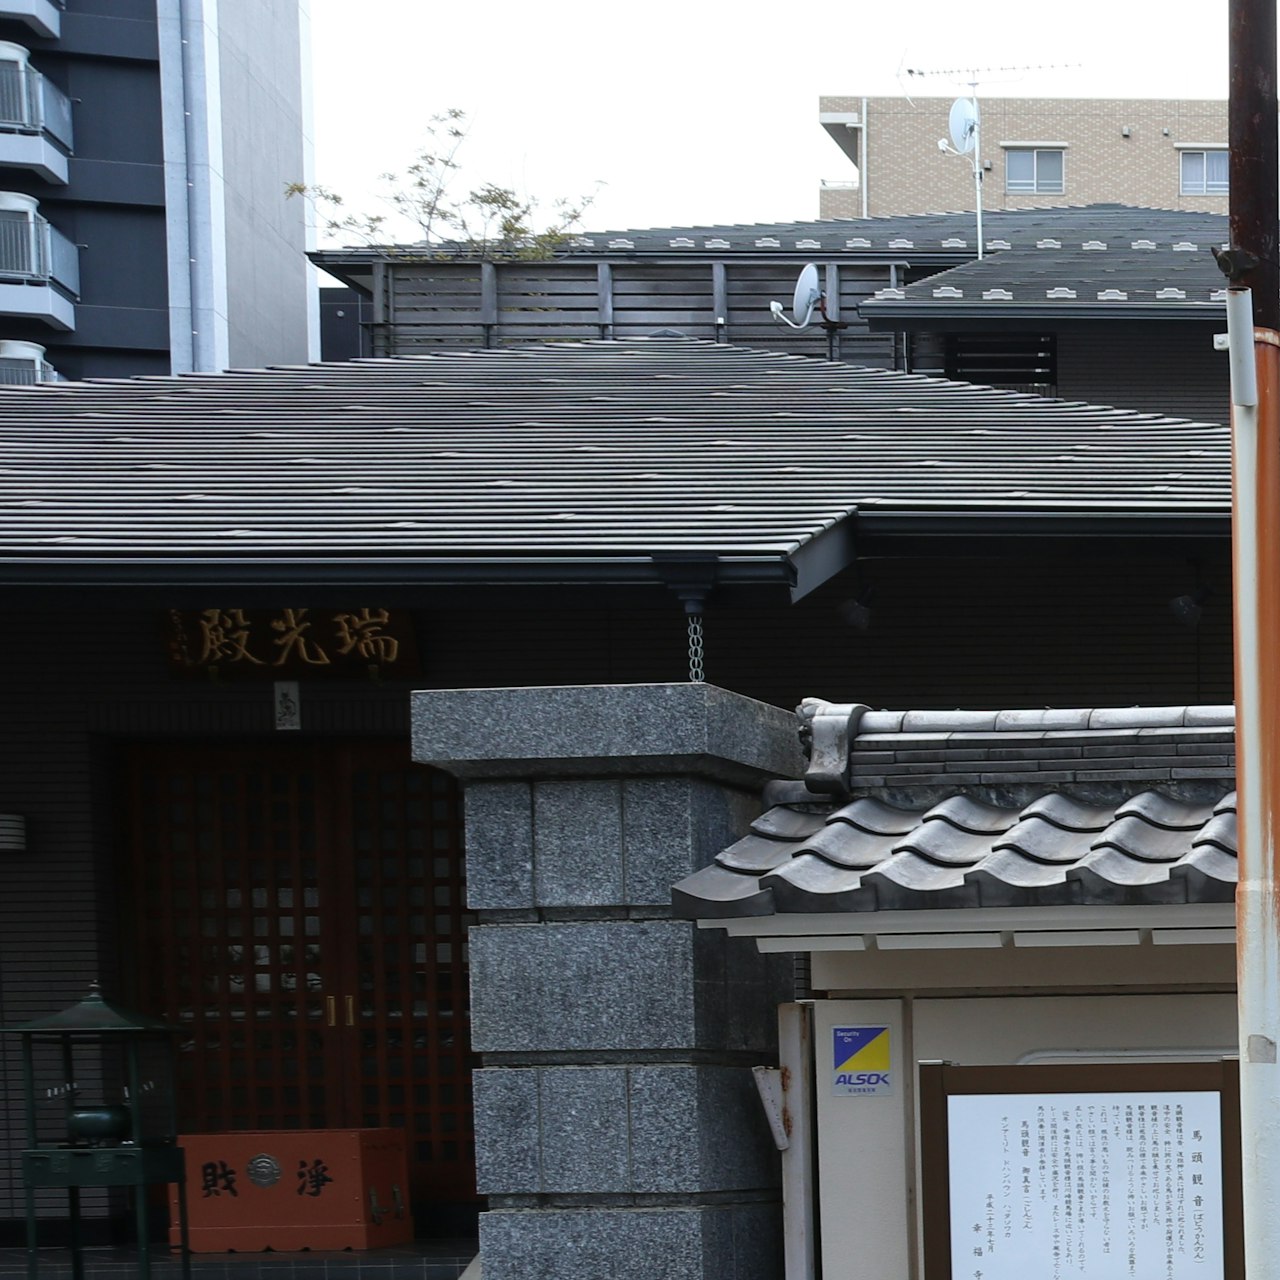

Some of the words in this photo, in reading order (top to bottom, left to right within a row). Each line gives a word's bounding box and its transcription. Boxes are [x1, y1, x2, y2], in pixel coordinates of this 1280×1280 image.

[198, 608, 400, 666] 瑞光殿
[835, 1073, 889, 1085] ALSOK
[971, 1222, 984, 1280] 幸福寺
